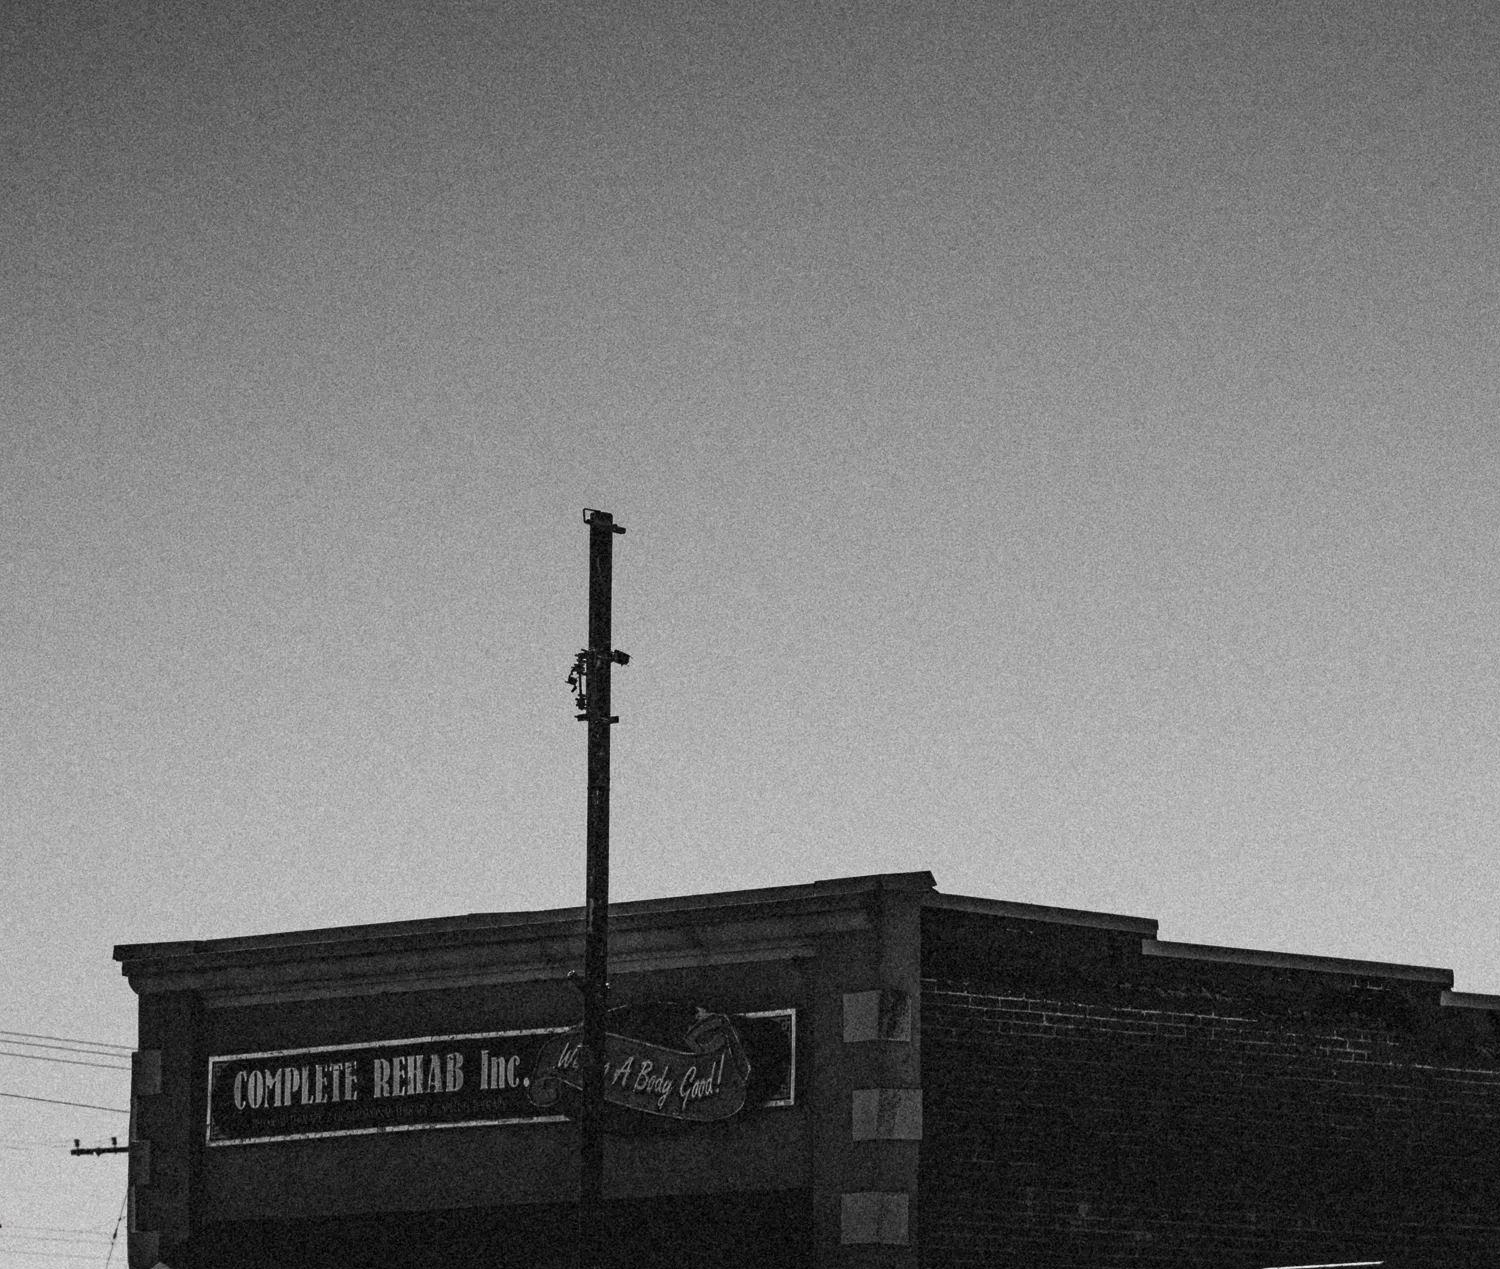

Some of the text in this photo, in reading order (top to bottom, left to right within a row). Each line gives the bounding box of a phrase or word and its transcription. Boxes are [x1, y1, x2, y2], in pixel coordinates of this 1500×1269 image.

[232, 1060, 358, 1111] COMPLETE
[372, 1051, 465, 1100] REHAB
[479, 1048, 531, 1091] Inc.
[611, 1056, 635, 1087] A
[634, 1060, 673, 1110] Body
[678, 1052, 726, 1110] Good!
